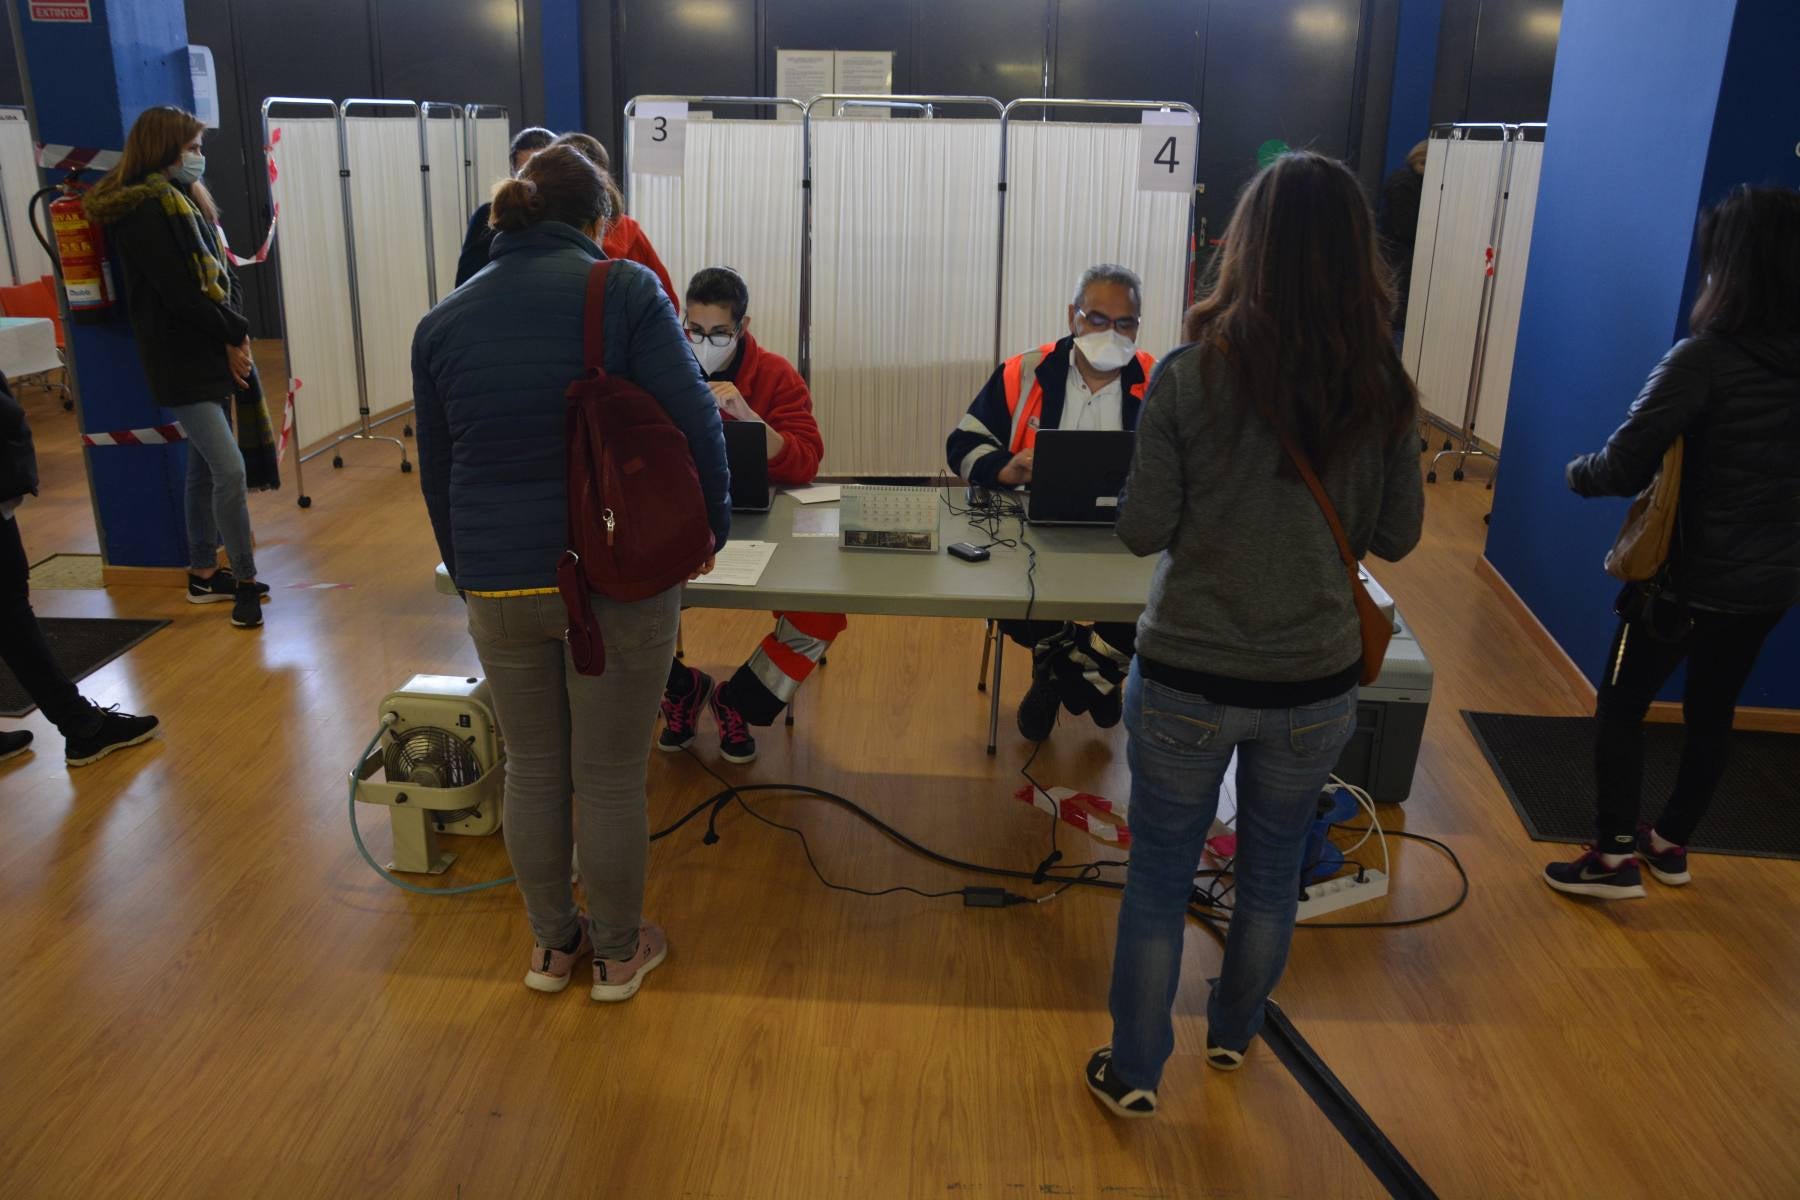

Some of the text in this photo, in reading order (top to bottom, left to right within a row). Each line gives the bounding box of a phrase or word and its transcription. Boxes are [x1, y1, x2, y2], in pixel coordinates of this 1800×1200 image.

[35, 7, 83, 18] EXTINTOR
[651, 115, 668, 142] 3
[1153, 136, 1180, 174] 4
